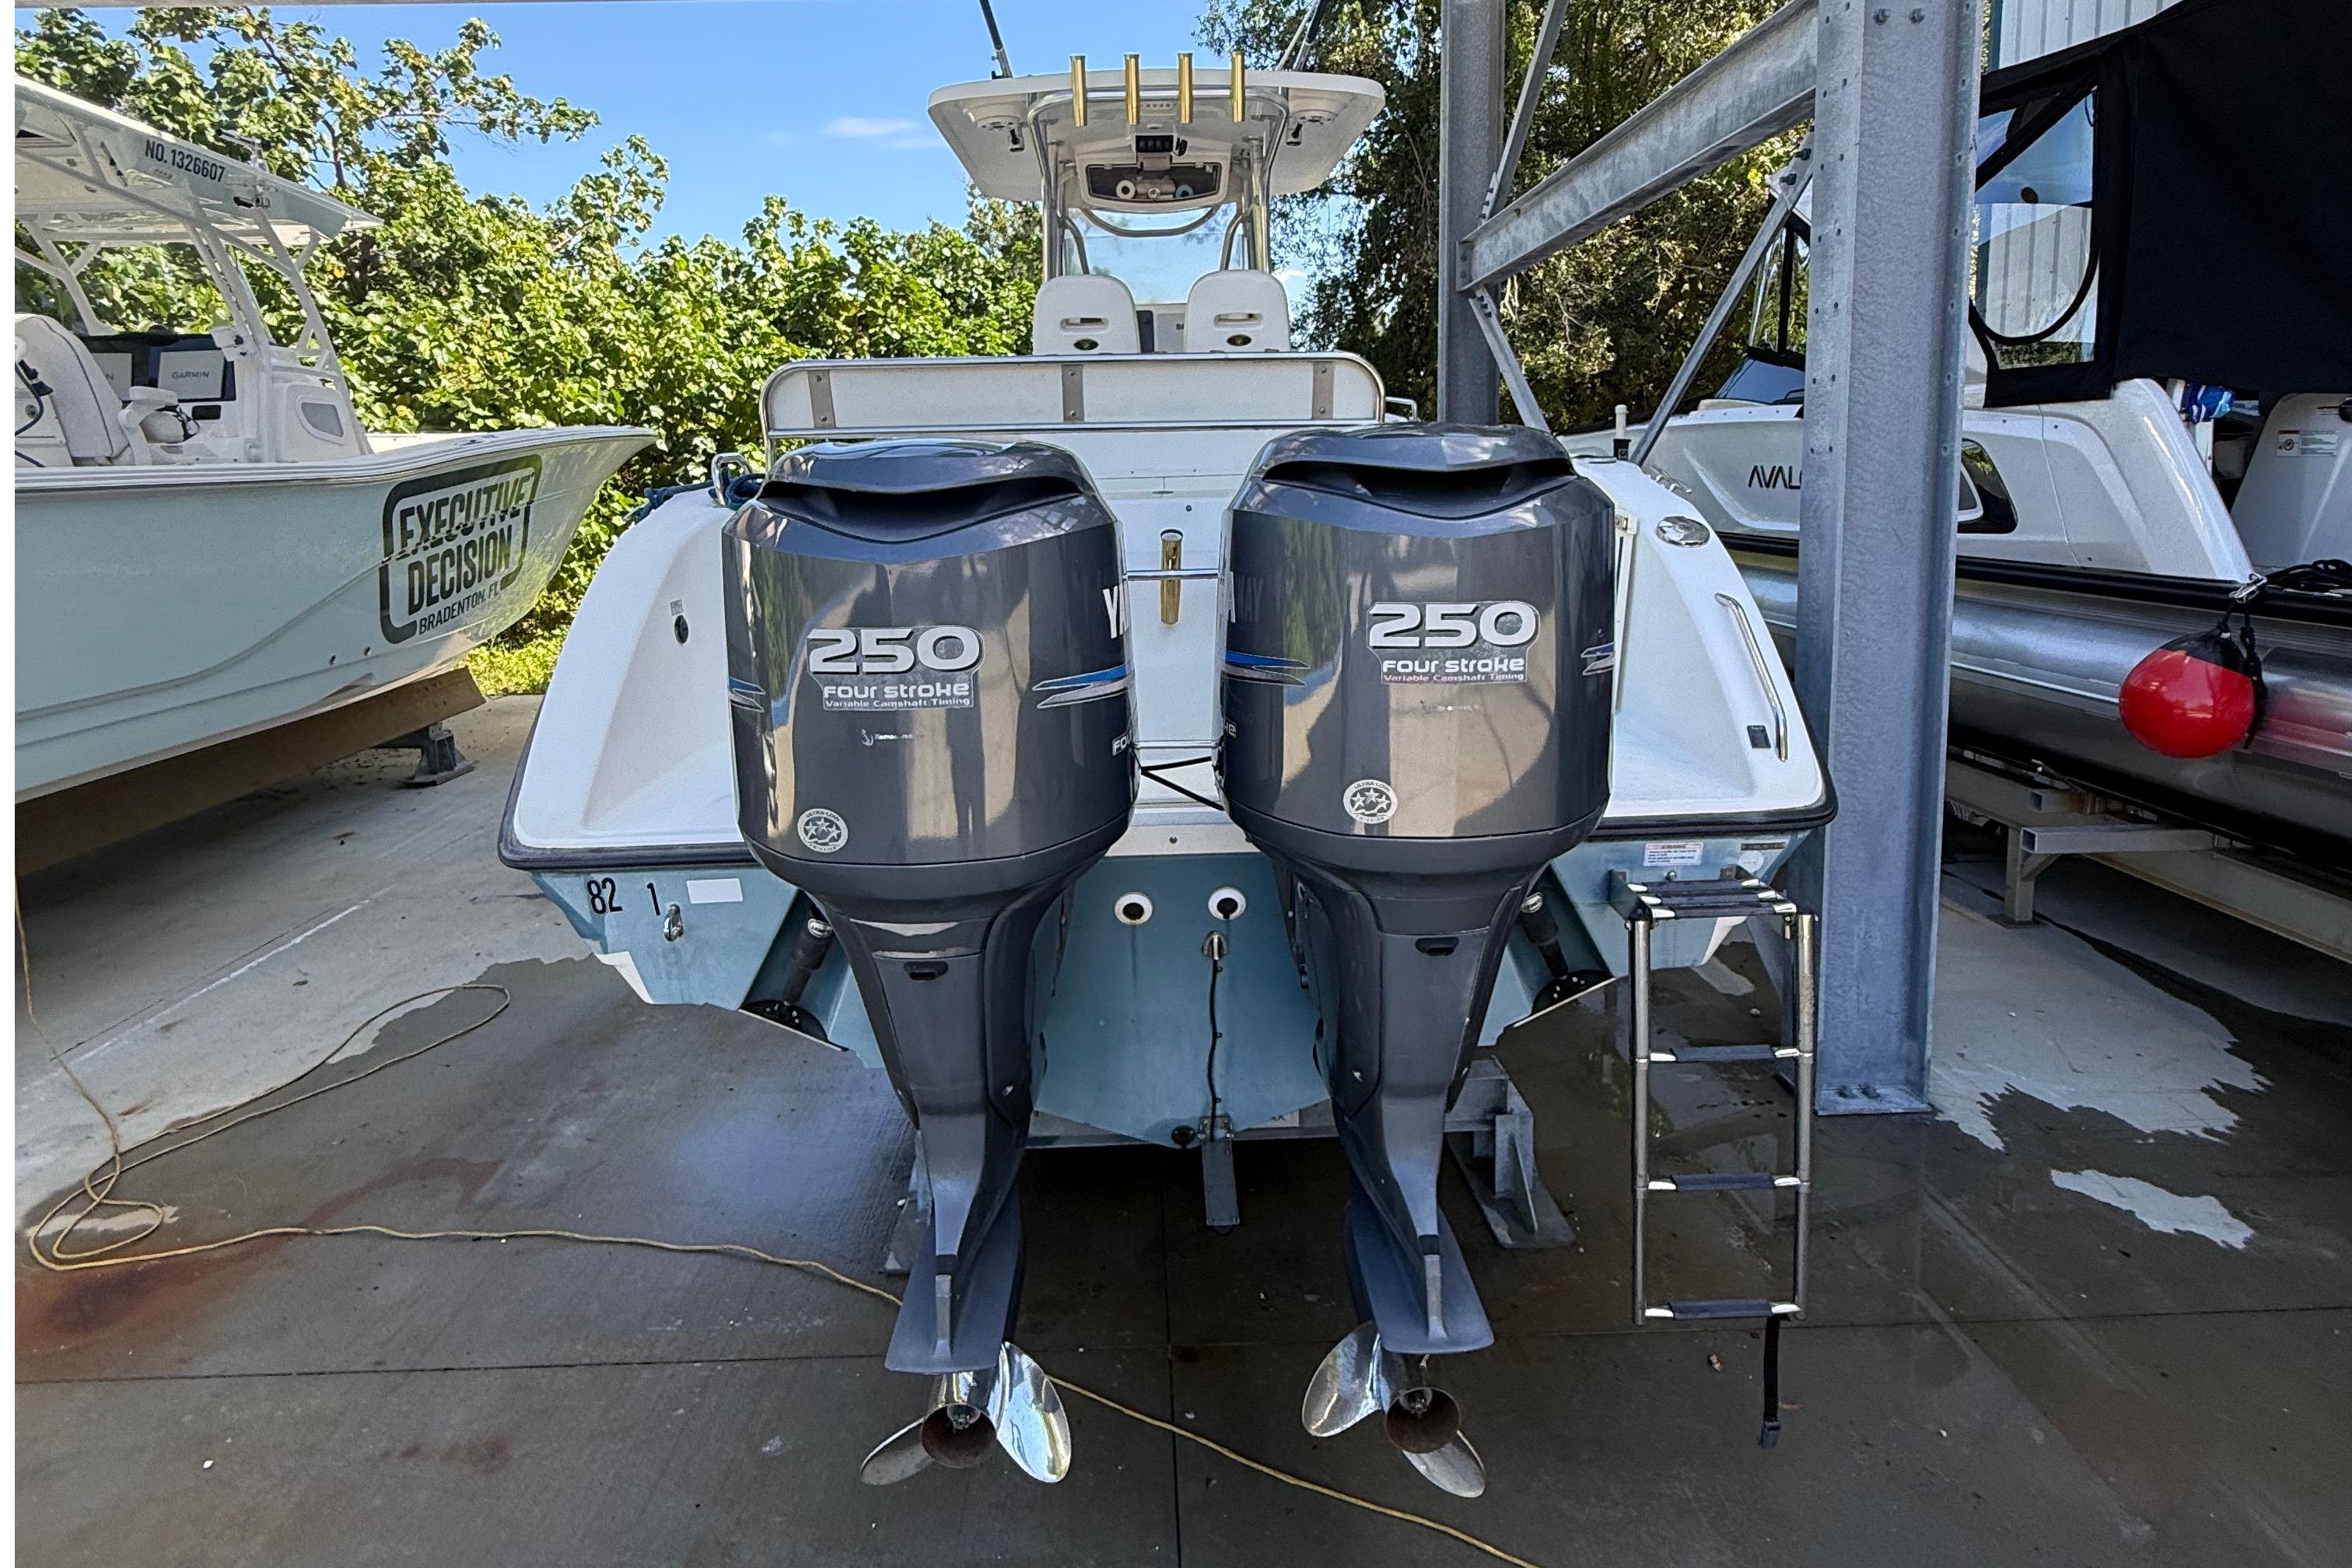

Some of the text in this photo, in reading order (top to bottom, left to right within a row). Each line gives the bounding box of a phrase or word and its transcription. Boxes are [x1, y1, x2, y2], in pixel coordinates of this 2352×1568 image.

[145, 139, 226, 183] NO. 1326607
[1748, 465, 1803, 490] AVAL
[396, 477, 530, 561] EXECUTIVE
[408, 524, 513, 617] DECISION
[488, 581, 500, 600] FL
[1369, 602, 1538, 649] 250
[807, 626, 982, 674] 250
[1433, 674, 1485, 682] Camshaft
[1489, 672, 1524, 681] Timing
[873, 699, 927, 708] Camshaft
[932, 698, 971, 706] Timing
[587, 877, 661, 916] 82 1
